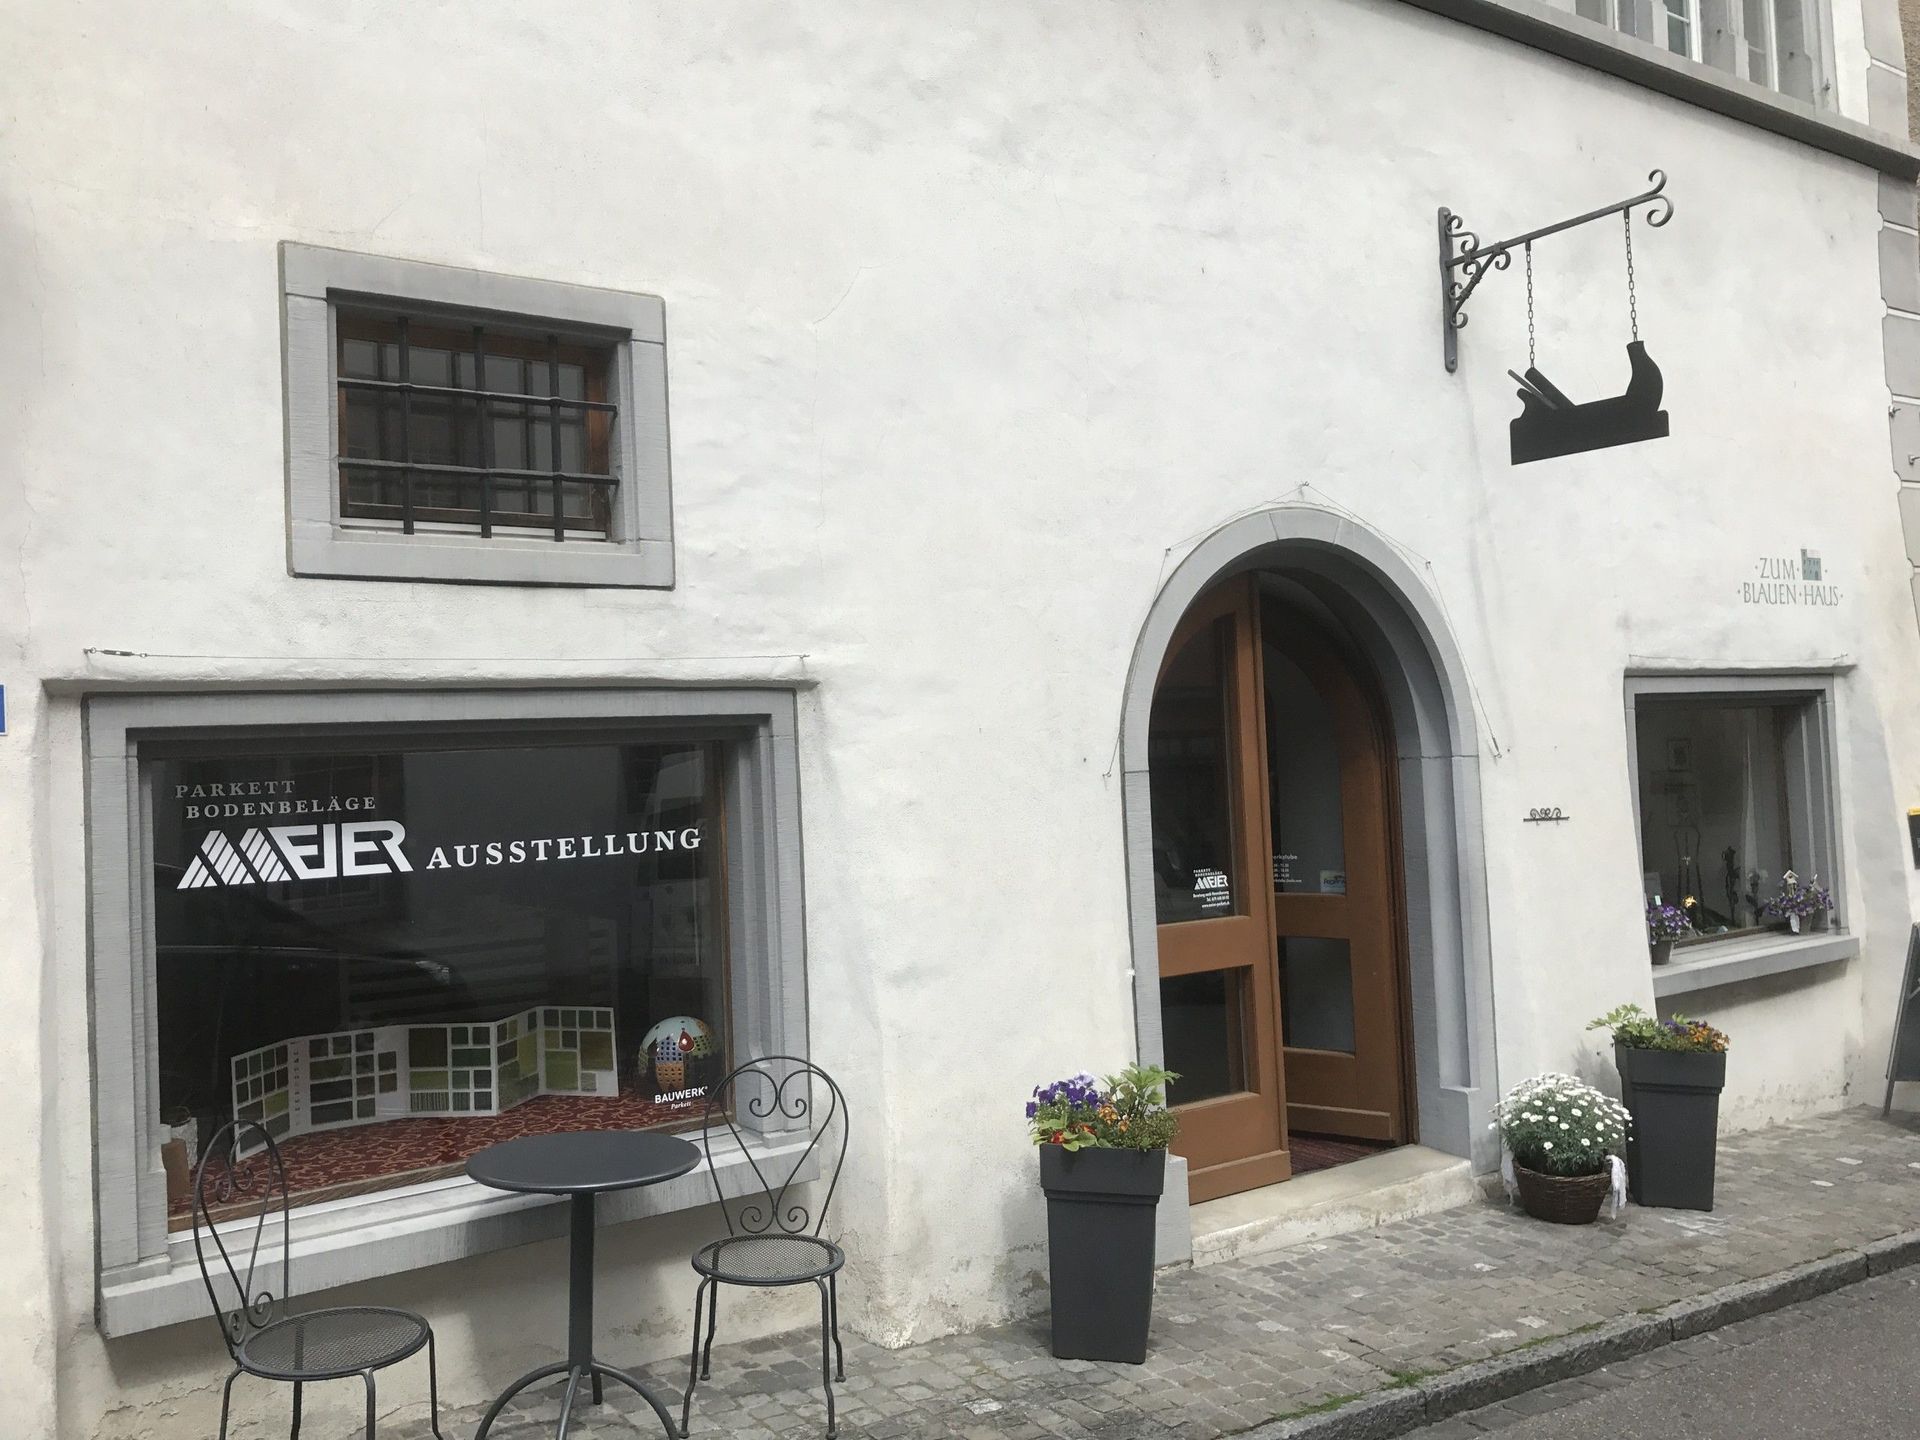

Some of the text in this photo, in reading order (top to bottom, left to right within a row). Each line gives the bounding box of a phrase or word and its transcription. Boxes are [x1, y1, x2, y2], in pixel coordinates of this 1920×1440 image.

[1759, 557, 1796, 580] ZUM
[1743, 581, 1840, 606] BLAUEN HAUS
[175, 780, 296, 798] PARKETT
[186, 795, 377, 819] BODENBELÄGE
[176, 819, 414, 890] MEIER
[426, 827, 701, 870] AUSSTELLUNG
[1194, 874, 1229, 890] MEIER
